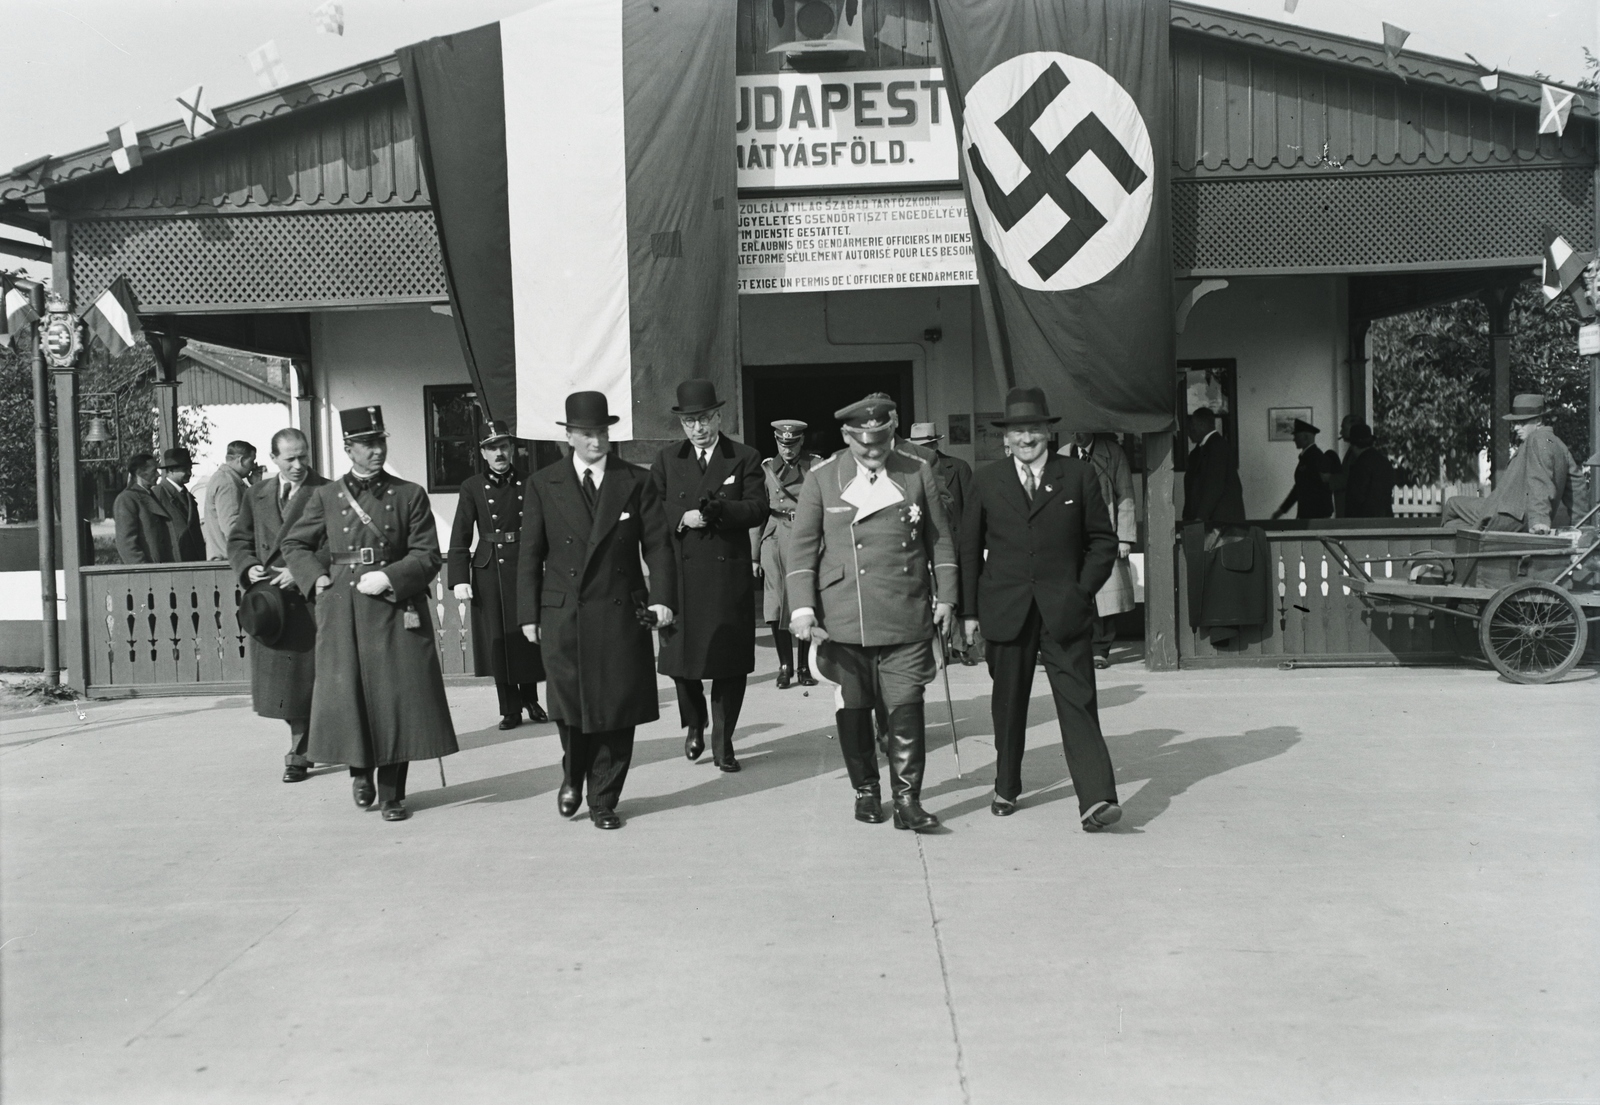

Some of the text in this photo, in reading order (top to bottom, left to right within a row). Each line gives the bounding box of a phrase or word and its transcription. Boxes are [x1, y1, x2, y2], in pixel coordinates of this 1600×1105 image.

[742, 226, 851, 239] IM DIENSTE GESTATTET.
[742, 240, 793, 252] ERLAUBNIS
[797, 239, 815, 250] DES
[818, 236, 883, 249] GENDARMERIE
[886, 235, 929, 246] OFFICIERS
[932, 234, 942, 243] IM
[893, 247, 917, 258] POUR
[920, 247, 938, 257] LES
[781, 278, 792, 288] UN
[796, 276, 829, 287] PERMIS
[832, 275, 844, 286] DE
[896, 272, 907, 283] DE
[909, 270, 973, 282] GENDARMERIE
